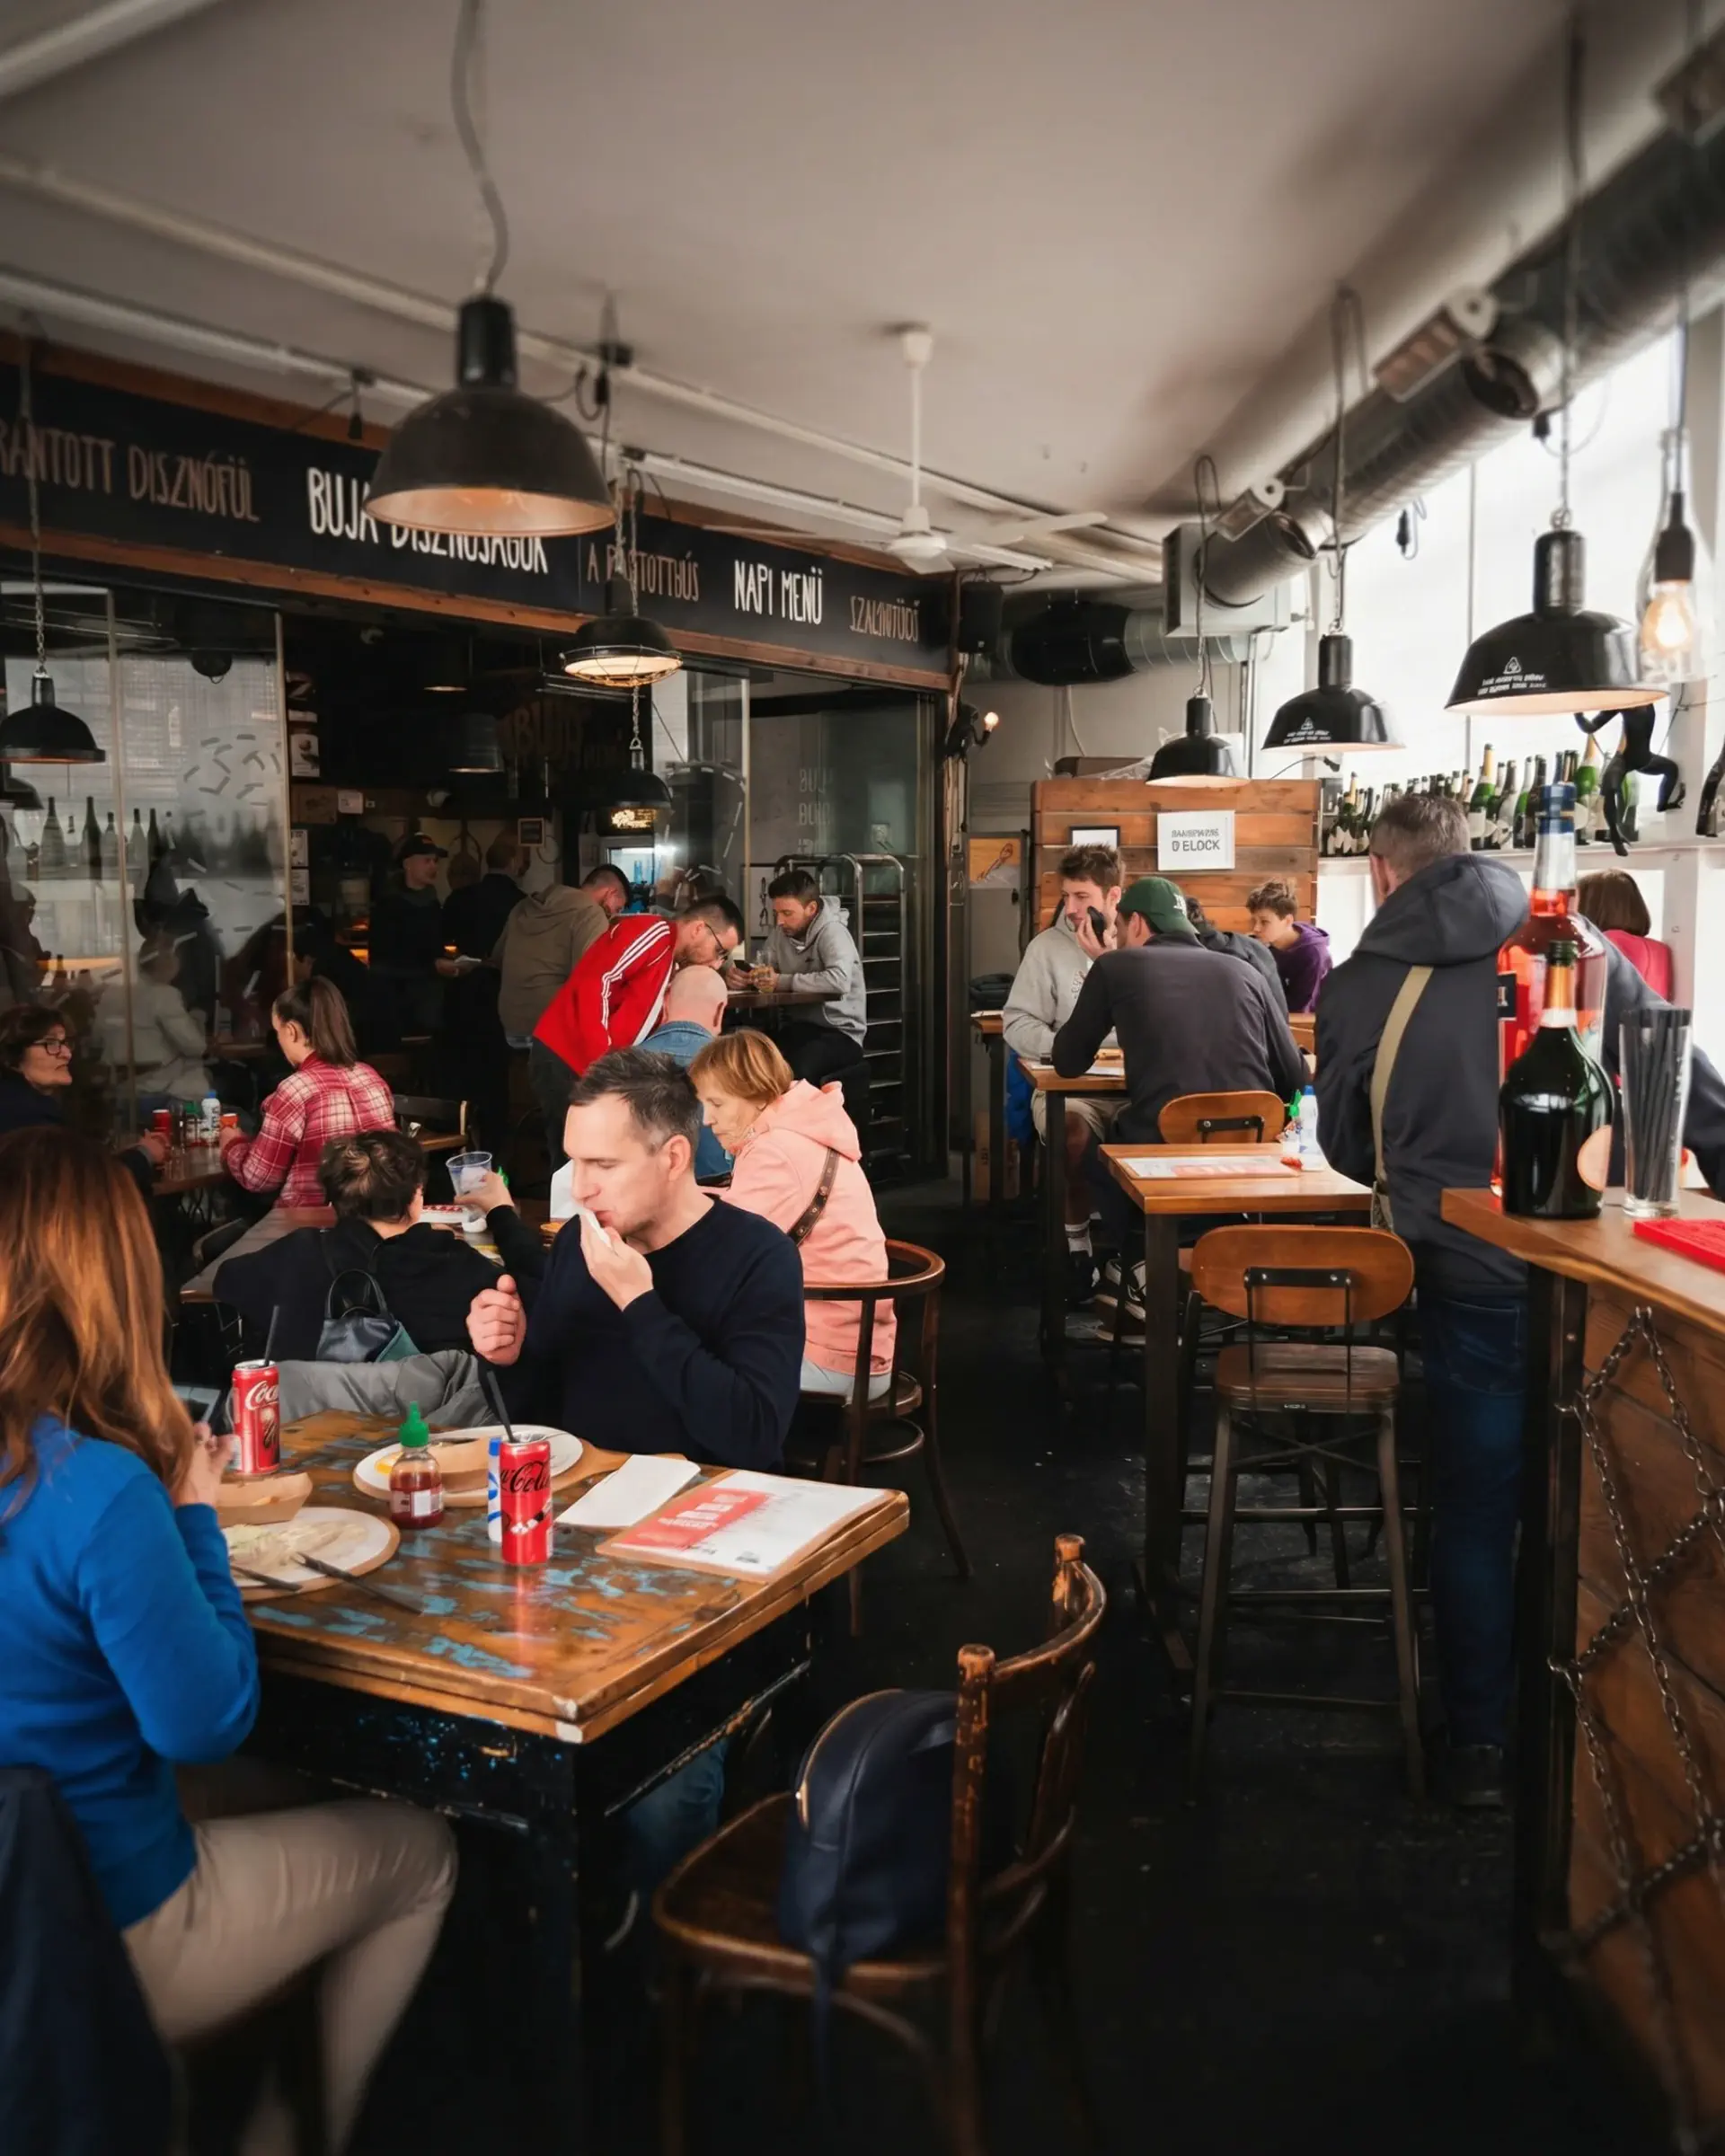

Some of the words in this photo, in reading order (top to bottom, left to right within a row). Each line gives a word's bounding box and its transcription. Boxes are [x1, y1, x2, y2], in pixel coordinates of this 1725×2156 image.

[306, 465, 379, 543] BUJA
[587, 542, 600, 584] A
[734, 559, 774, 616] NAPI
[781, 565, 823, 625] MENÜ
